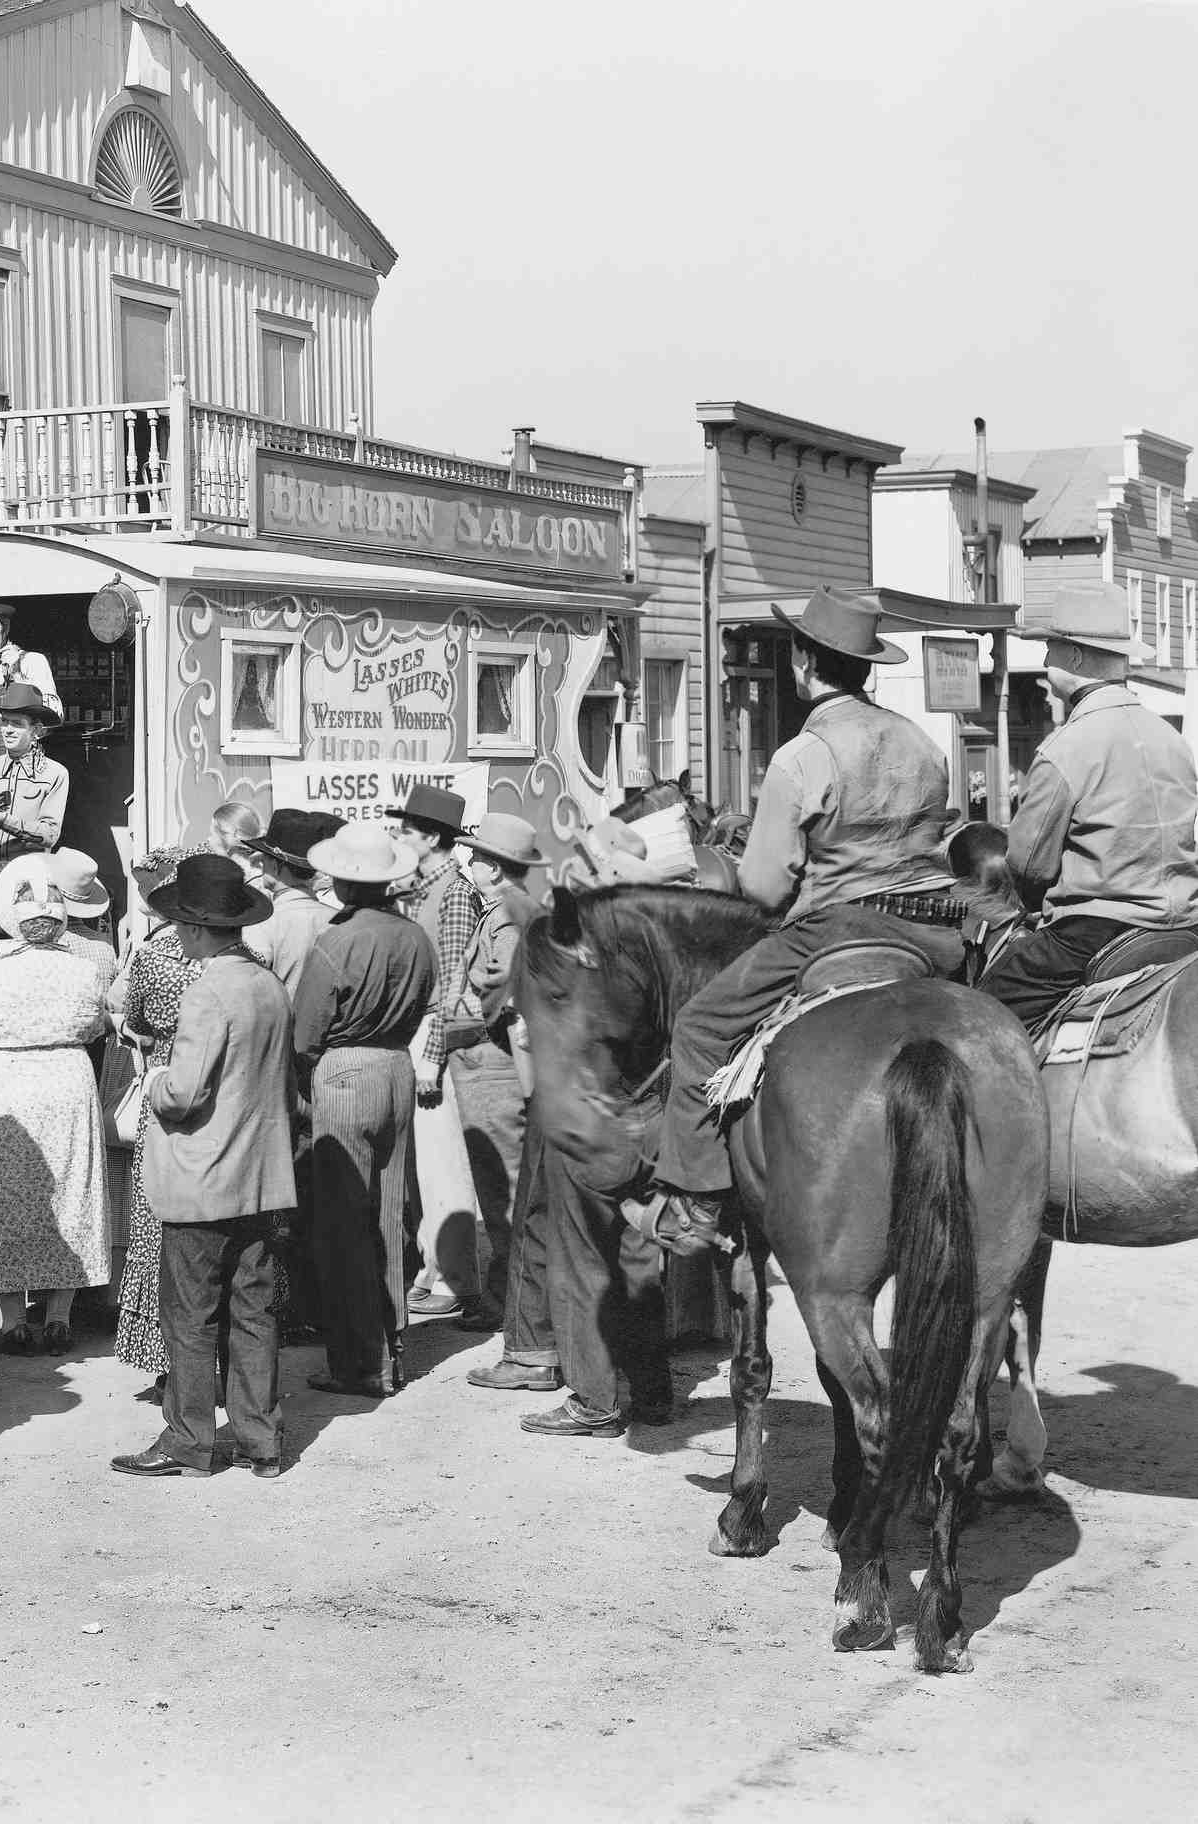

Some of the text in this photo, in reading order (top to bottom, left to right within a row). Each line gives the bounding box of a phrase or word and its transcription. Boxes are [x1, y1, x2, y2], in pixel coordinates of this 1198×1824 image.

[264, 470, 608, 561] BIG HORN SALOON
[352, 647, 425, 693] LASSES
[311, 701, 448, 730] WESTERN WONDER
[306, 773, 380, 800] LASSES
